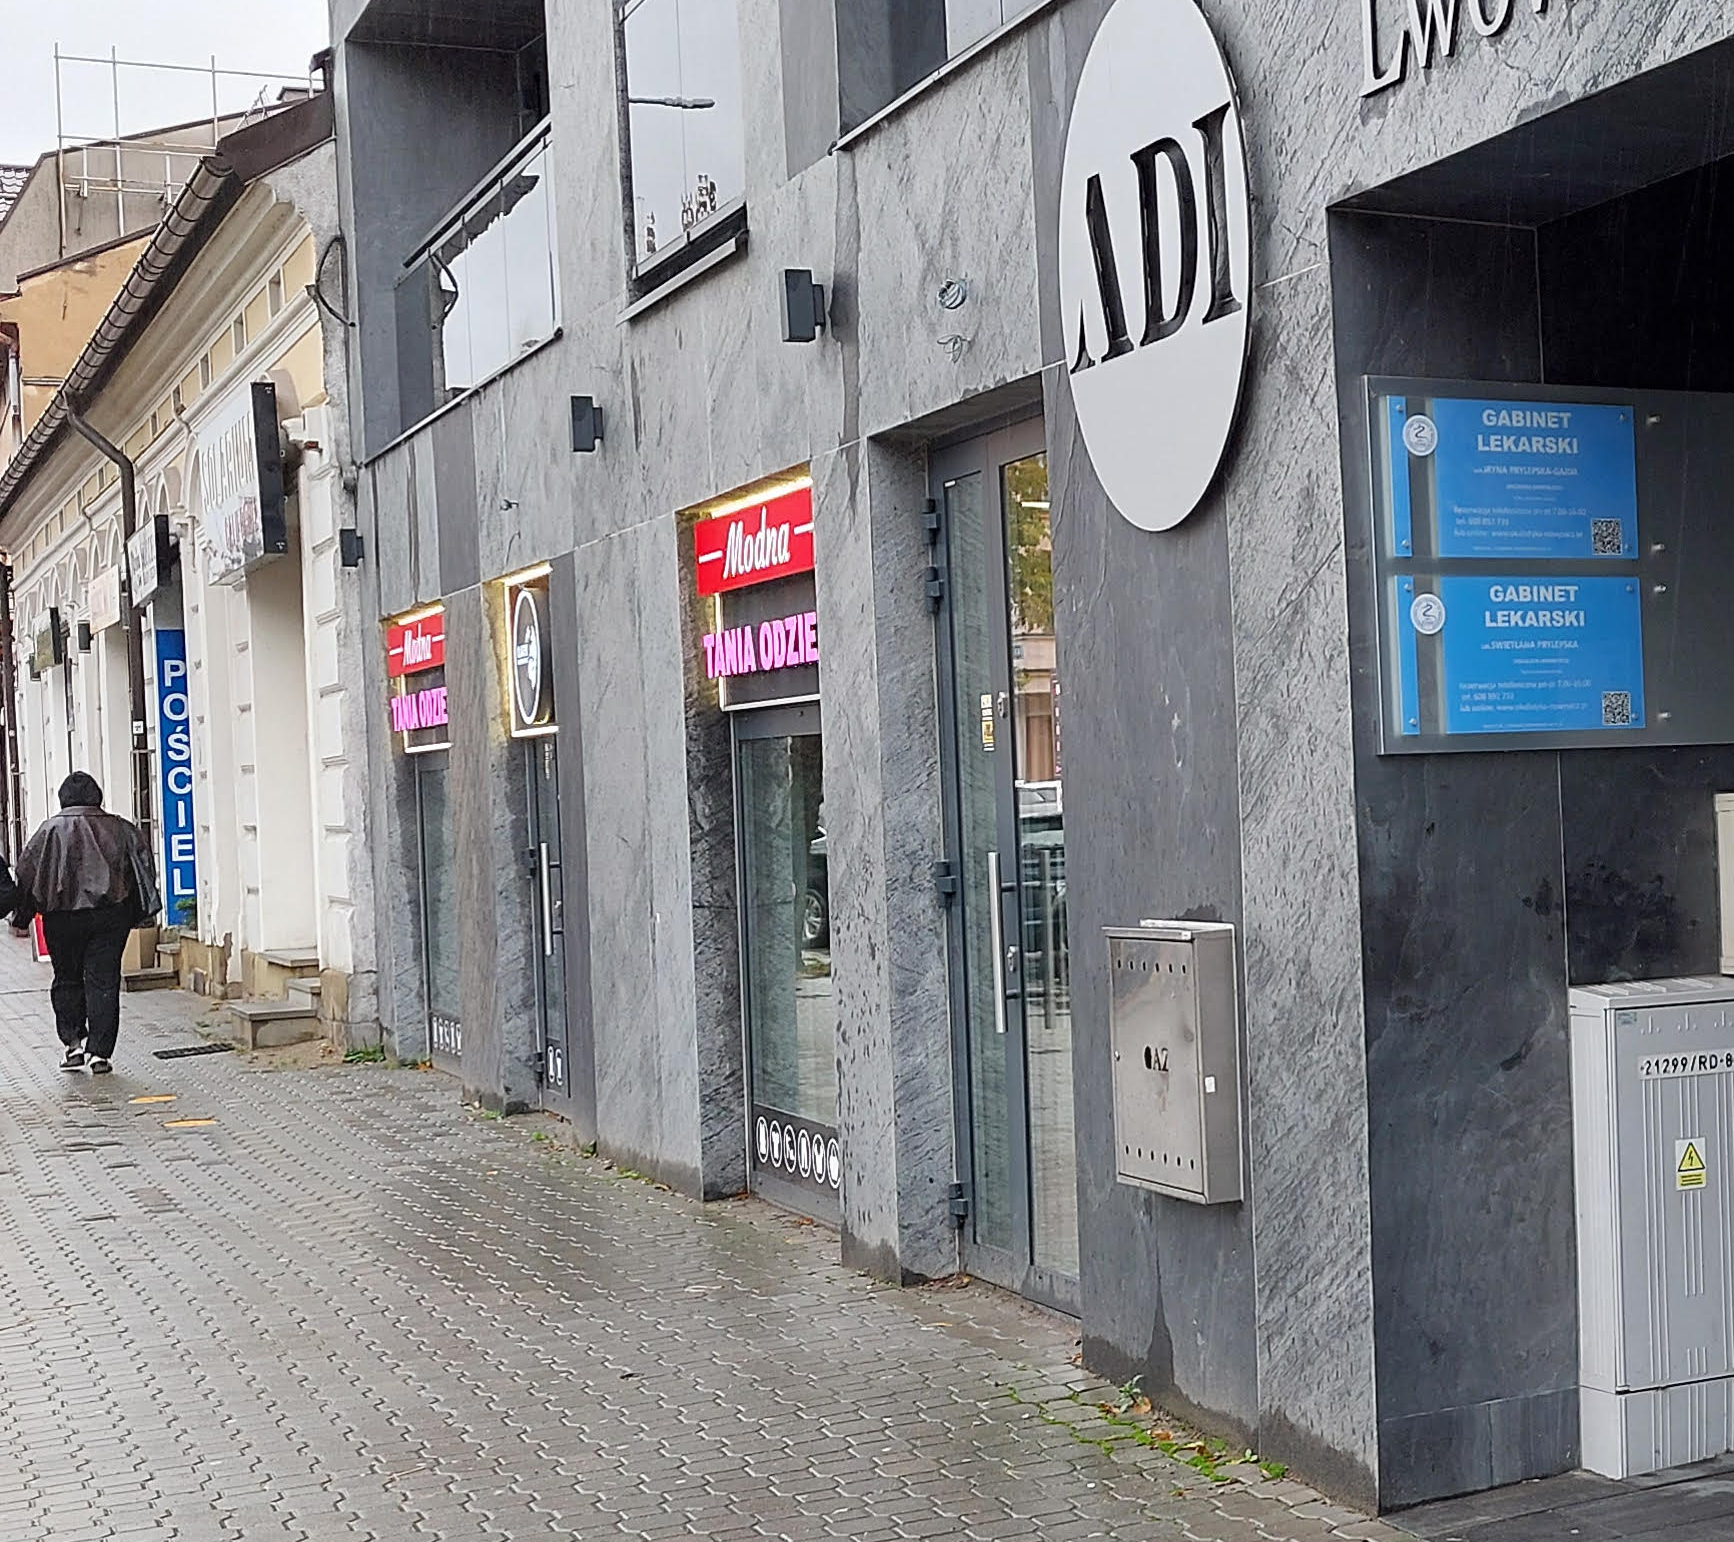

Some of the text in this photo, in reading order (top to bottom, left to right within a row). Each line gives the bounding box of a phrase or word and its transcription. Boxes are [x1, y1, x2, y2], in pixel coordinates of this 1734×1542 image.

[1069, 100, 1242, 375] ADI
[1482, 409, 1572, 429] GABINET
[201, 411, 256, 514] SOLARIUM
[1477, 434, 1579, 454] LEKARSKI
[723, 506, 790, 579] Modna
[1490, 585, 1579, 602] GABINET
[1485, 610, 1585, 628] LEKARSKI
[403, 622, 432, 667] Modna
[702, 611, 820, 679] TANIA ODZIE
[391, 686, 449, 732] TANIA ODZIE
[162, 659, 196, 896] POŚCIEL
[1644, 1052, 1734, 1076] 21299/RD-8
